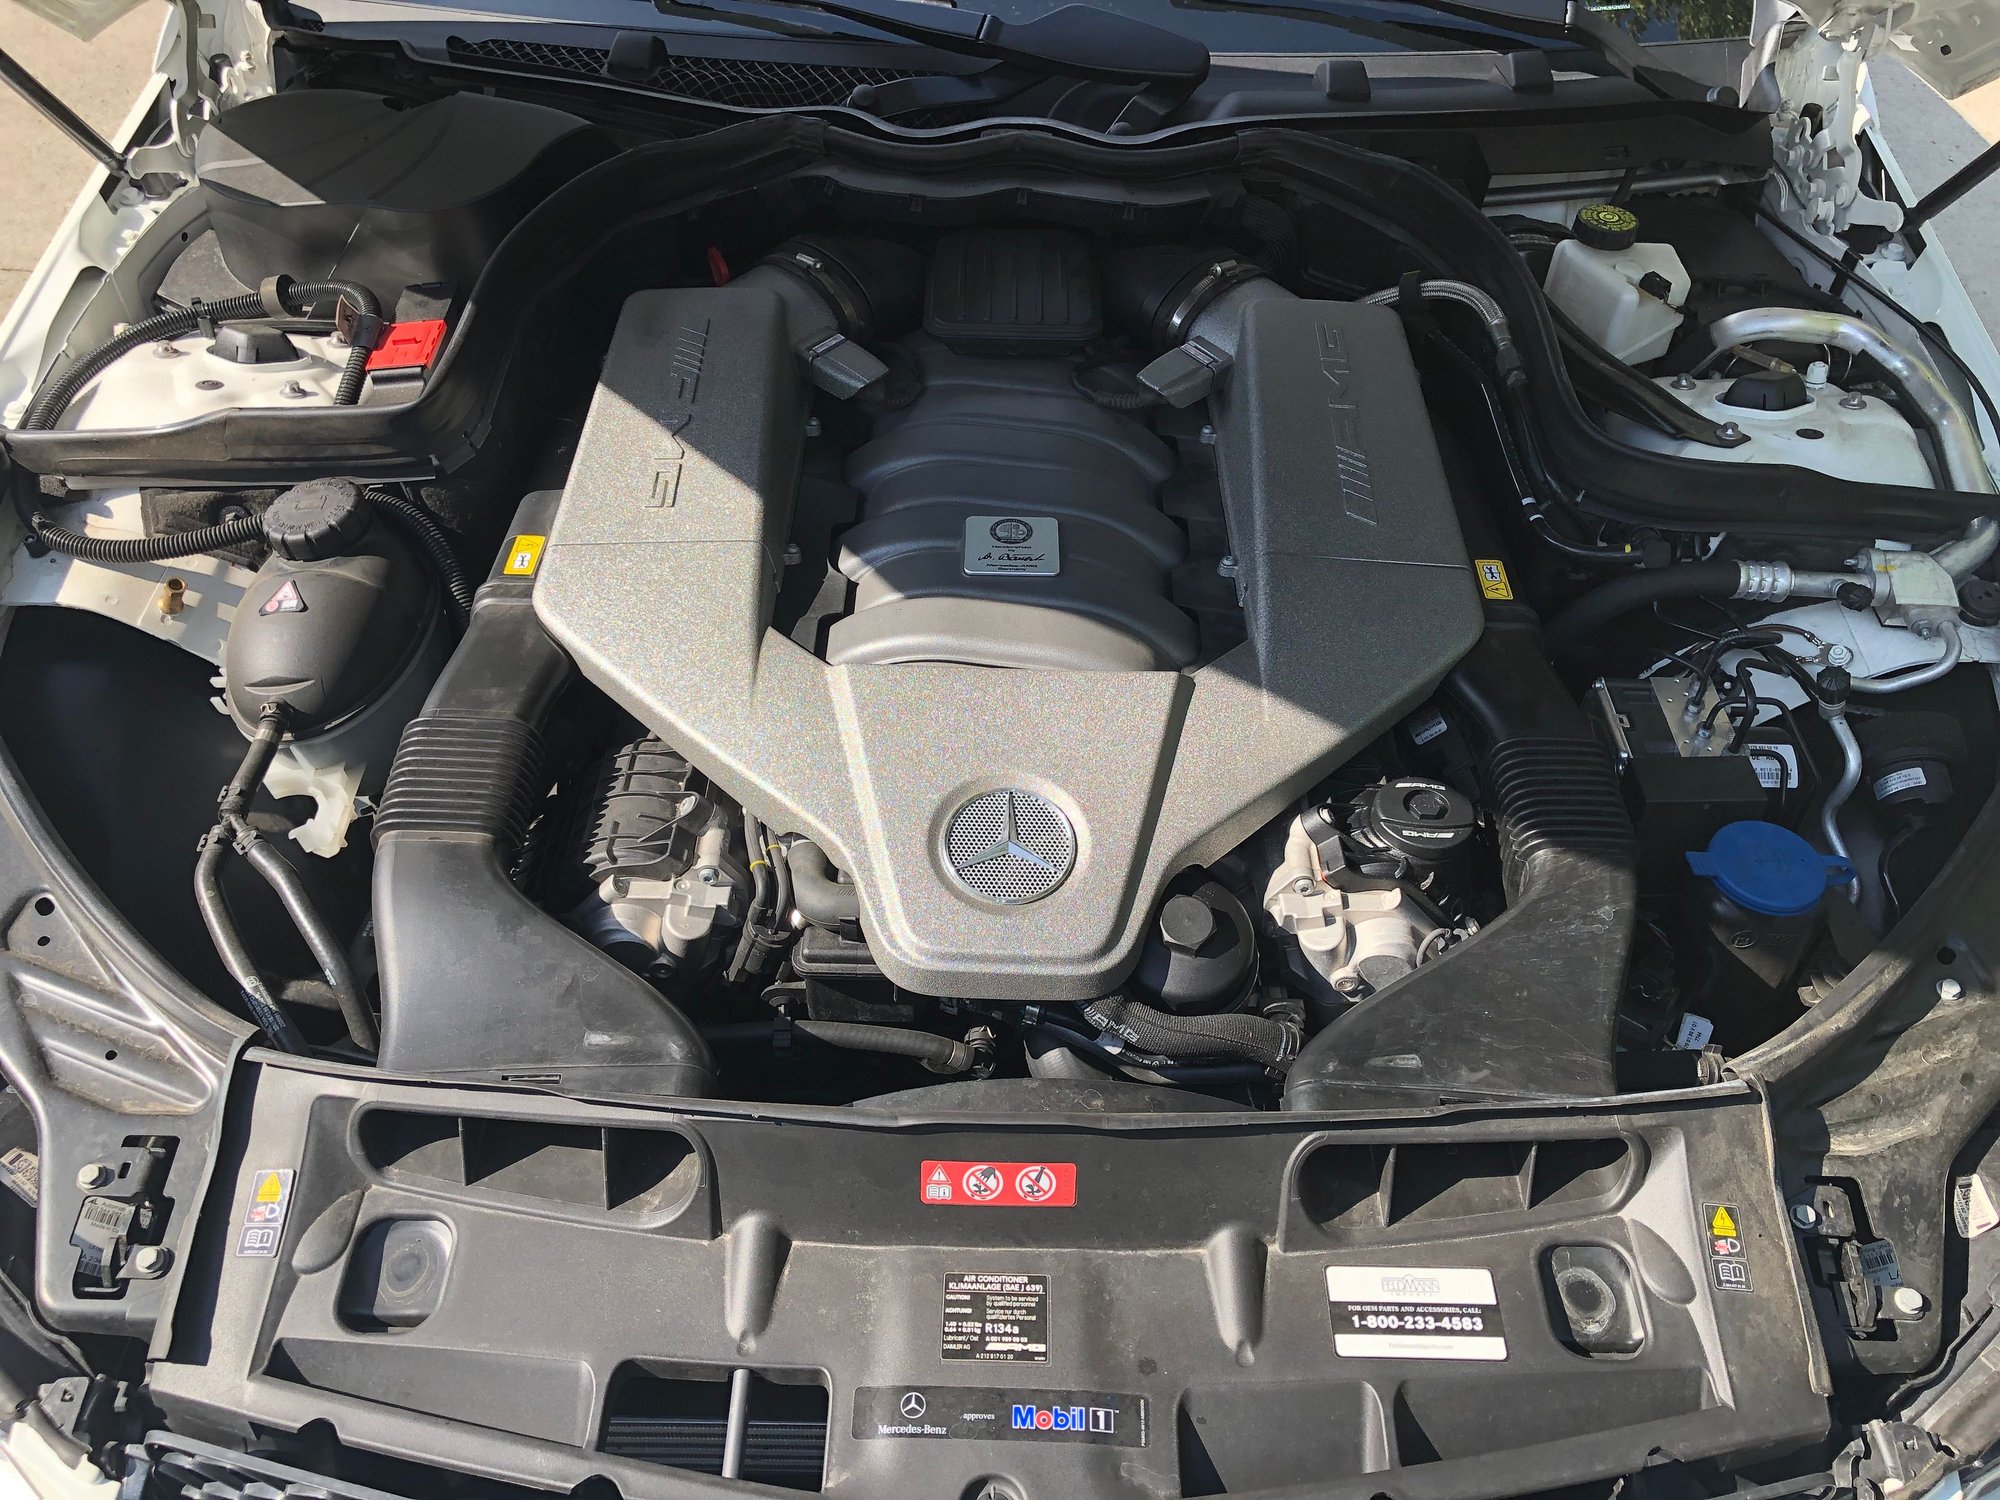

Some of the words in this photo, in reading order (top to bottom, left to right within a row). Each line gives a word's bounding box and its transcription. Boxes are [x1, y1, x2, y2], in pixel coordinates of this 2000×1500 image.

[977, 1275, 1028, 1283] CONDITIONER
[948, 1282, 1001, 1291] KLIMAANLAGE
[1003, 1284, 1020, 1292] (SAE
[1026, 1285, 1043, 1293] 639)
[1416, 1306, 1462, 1314] ACCESSORIES,
[1351, 1314, 1484, 1331] 1-800-233-4583
[985, 1323, 1019, 1334] R134a
[963, 1413, 996, 1421] approves
[1012, 1404, 1086, 1431] Mobil
[878, 1423, 947, 1435] Mercedes-Benz
